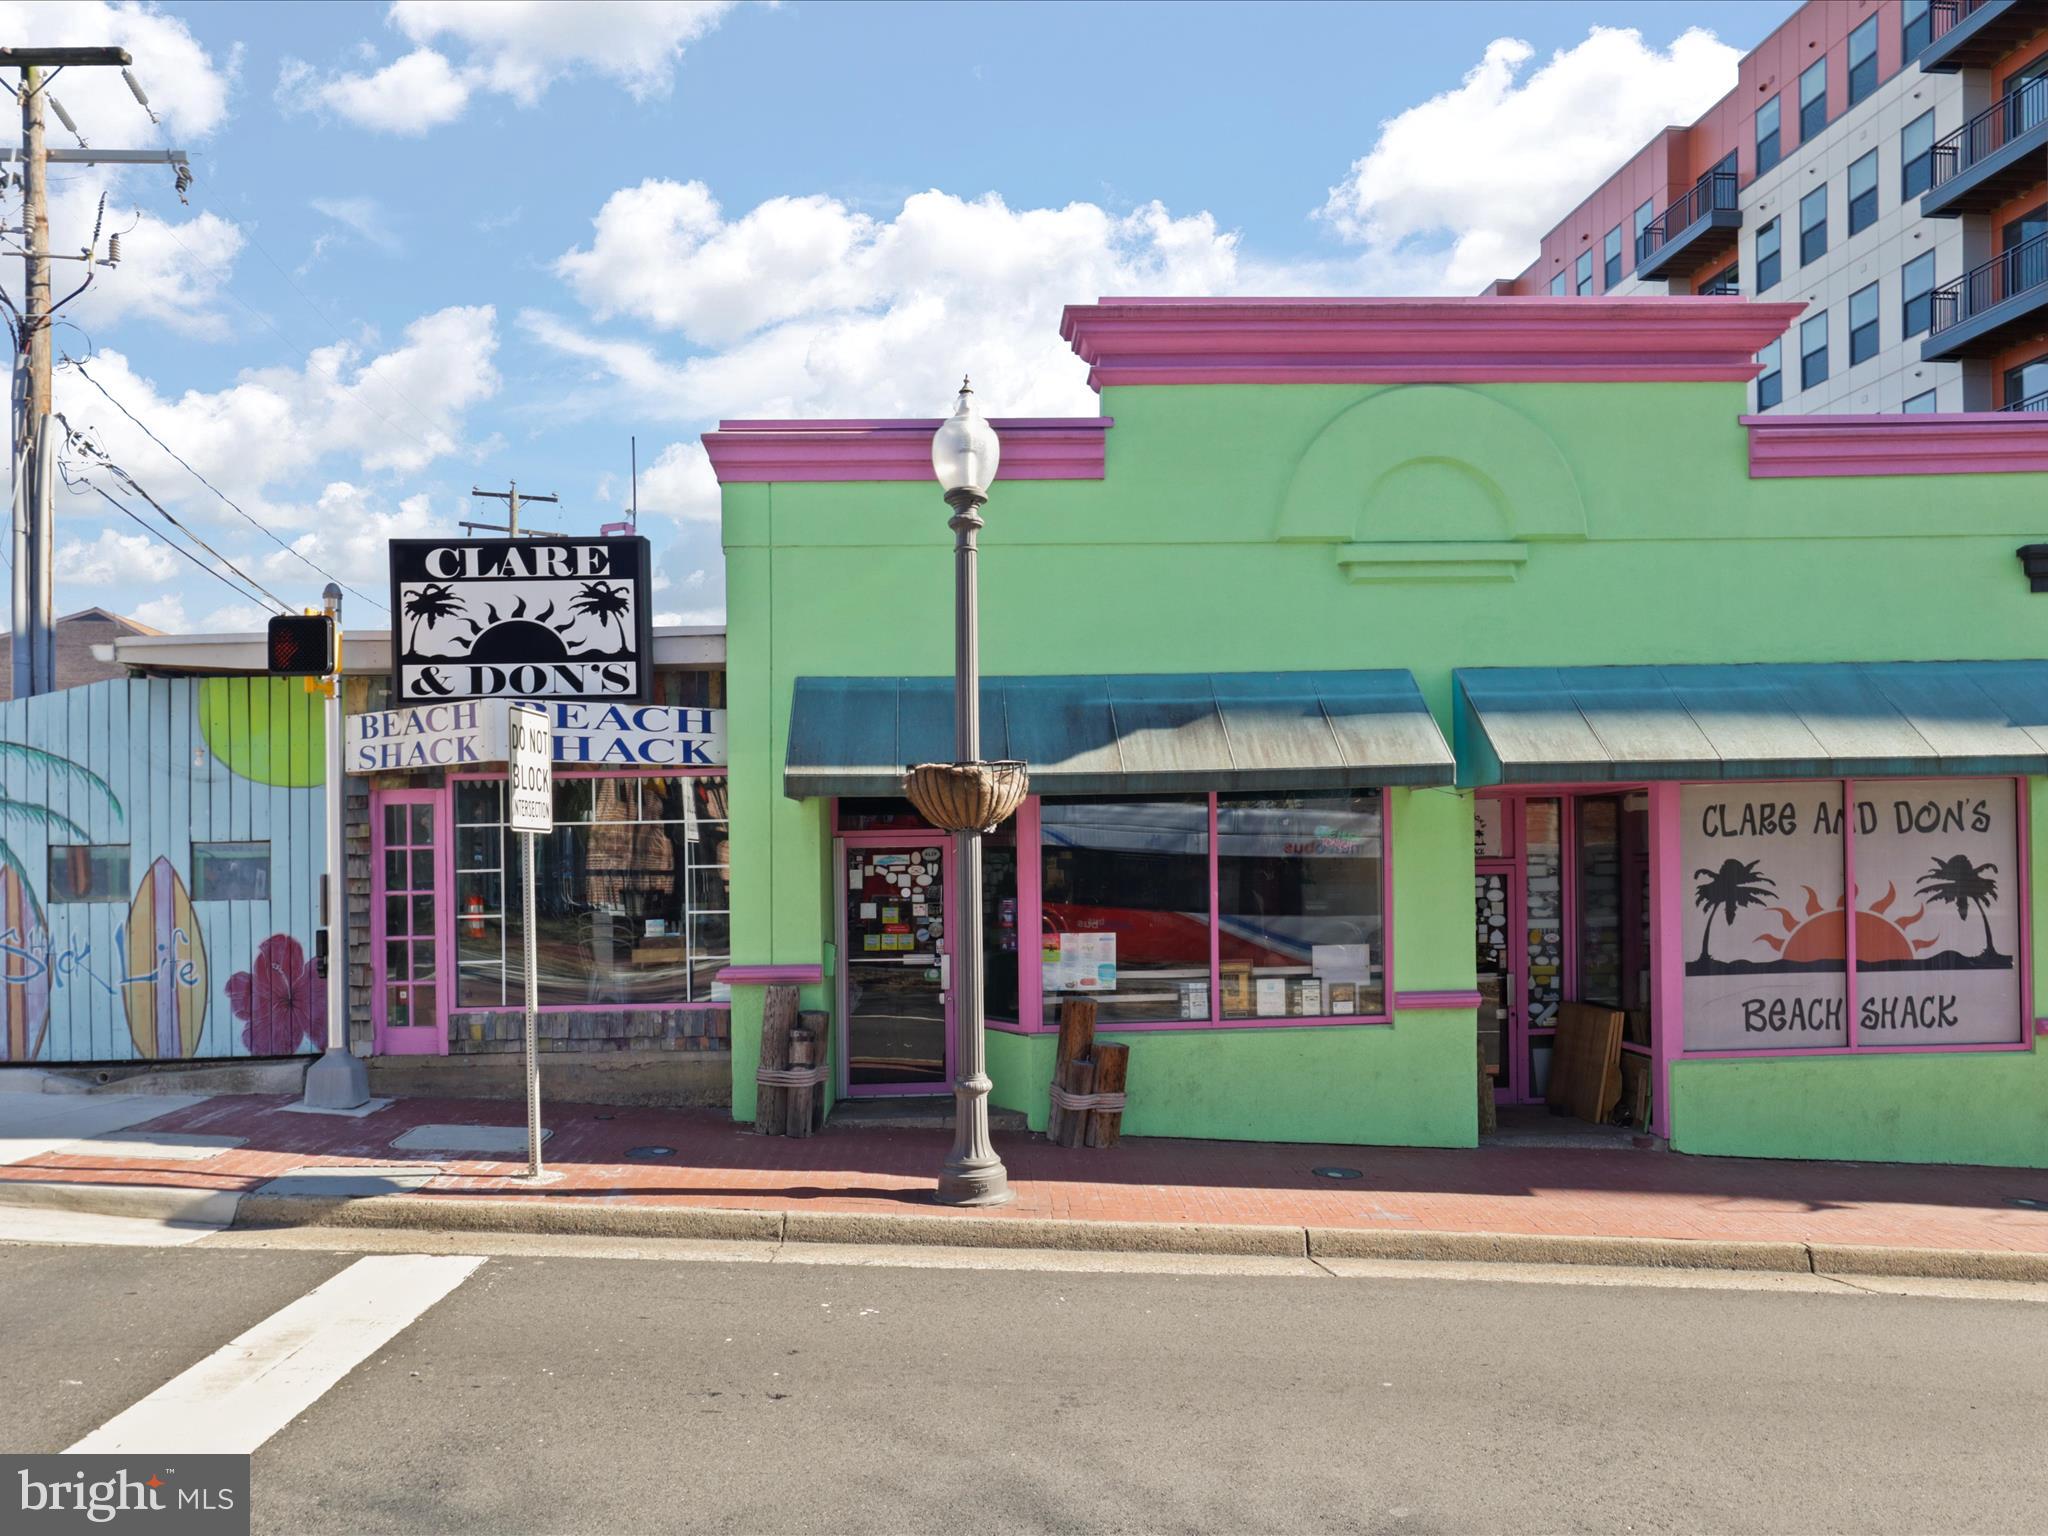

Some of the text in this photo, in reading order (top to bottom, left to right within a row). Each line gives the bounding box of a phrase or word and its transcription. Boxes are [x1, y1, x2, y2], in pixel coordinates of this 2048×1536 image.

[425, 545, 611, 579] CLARE
[411, 663, 631, 696] & DON'S
[360, 701, 480, 740] BEACH
[514, 701, 715, 734] EACH
[358, 735, 480, 770] SHACK
[512, 723, 548, 756] DO NOT
[550, 735, 714, 764] HACK
[513, 763, 549, 793] BLOCK
[511, 799, 550, 818] INTERSECTION
[1702, 801, 1798, 838] CLARE
[1893, 798, 1991, 835] DON'S
[114, 922, 199, 990] Life
[1742, 995, 1959, 1033] BEACH SHACK
